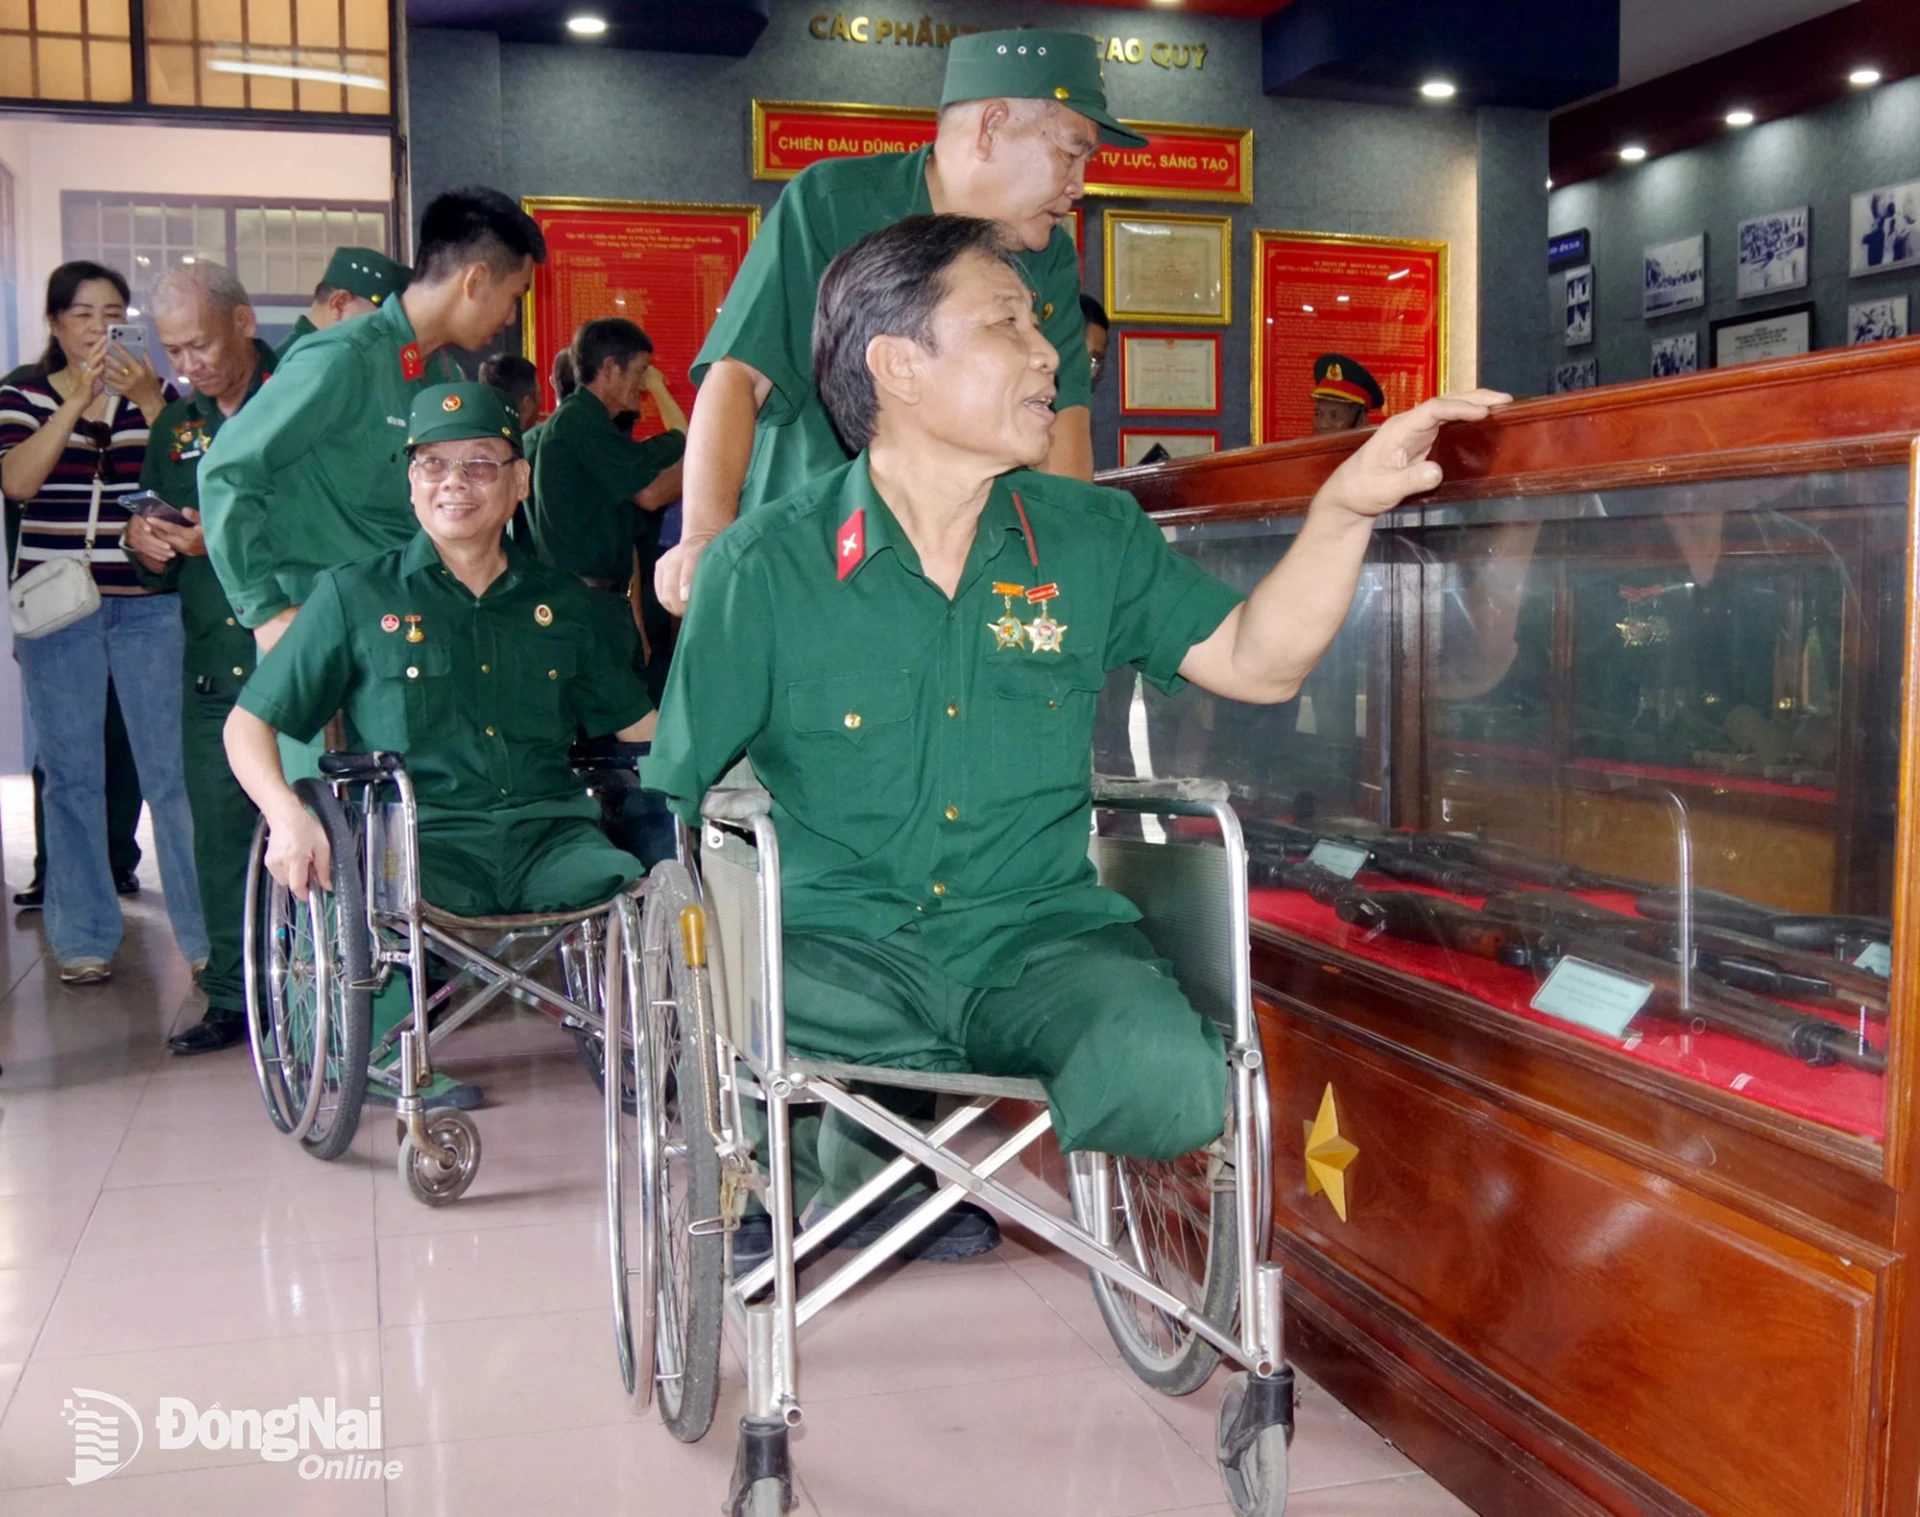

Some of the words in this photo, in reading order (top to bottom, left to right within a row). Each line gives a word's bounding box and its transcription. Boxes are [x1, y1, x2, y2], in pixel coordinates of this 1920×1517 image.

[810, 12, 869, 43] CÁC
[863, 138, 906, 153] DŨNG
[1100, 151, 1121, 168] TỰ
[1160, 153, 1197, 170] SÁNG
[1201, 157, 1229, 174] TẠO
